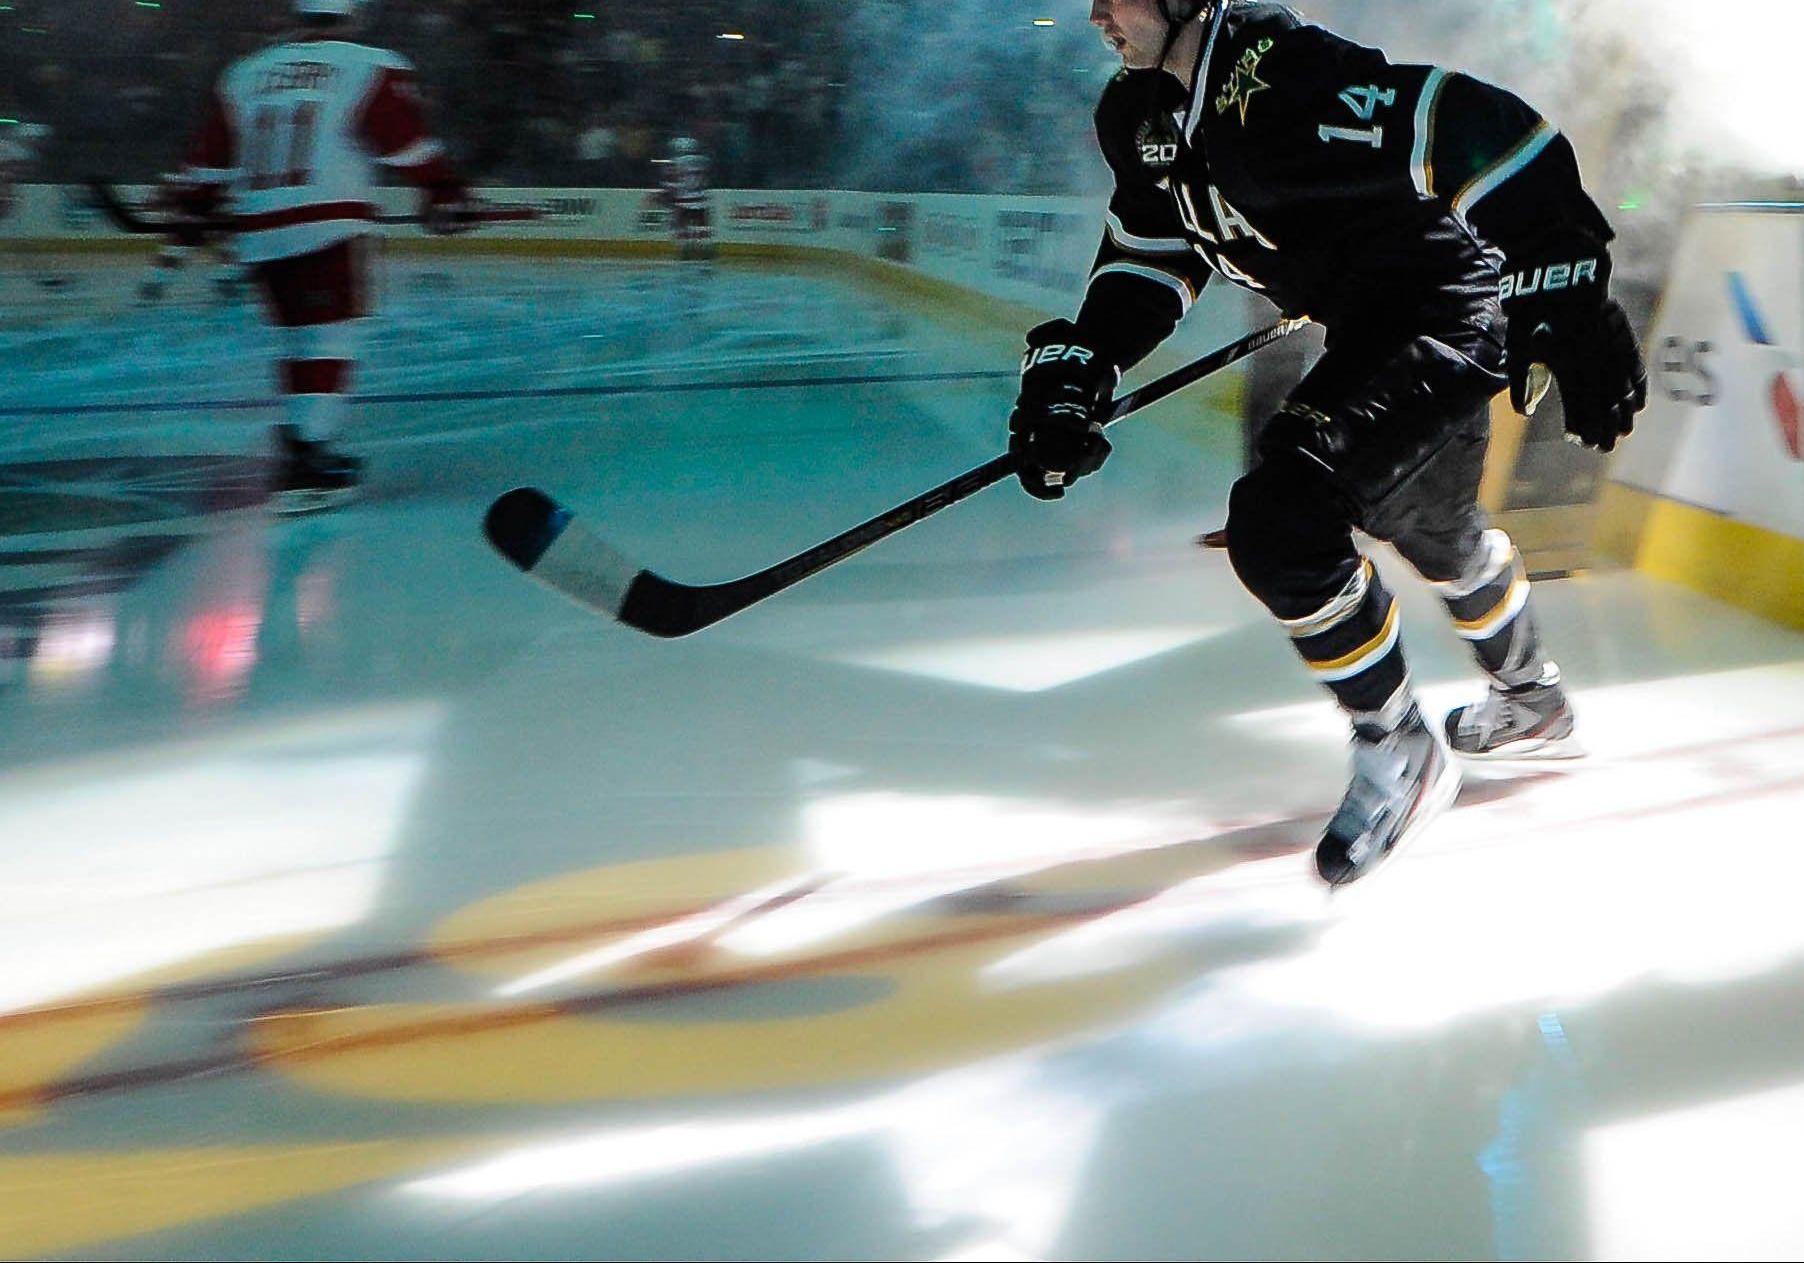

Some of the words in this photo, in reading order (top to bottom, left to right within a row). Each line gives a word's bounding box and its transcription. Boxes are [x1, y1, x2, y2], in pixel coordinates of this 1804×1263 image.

[1318, 84, 1395, 148] 14
[1142, 143, 1177, 162] 20
[1498, 259, 1597, 300] AUER
